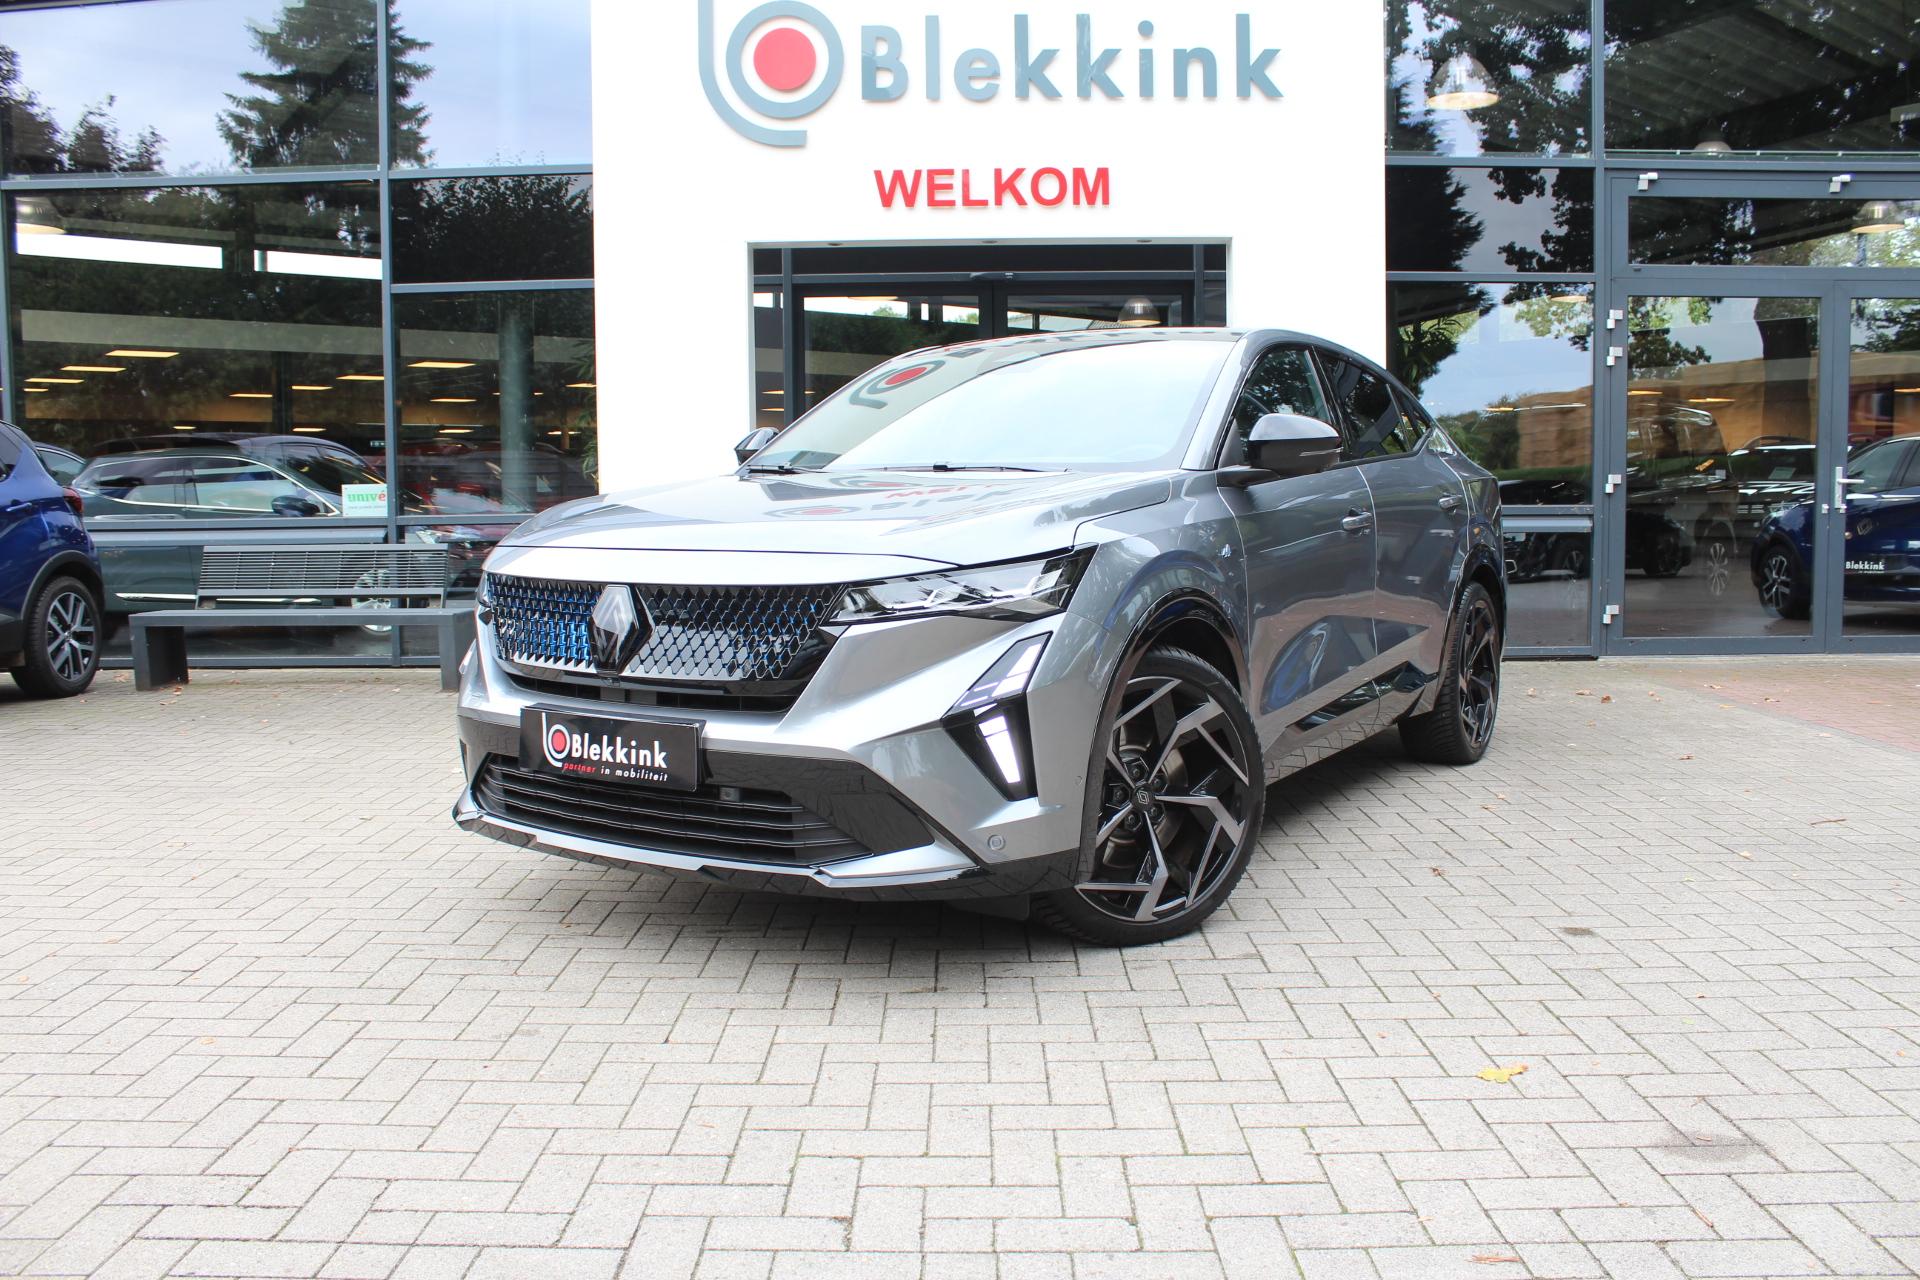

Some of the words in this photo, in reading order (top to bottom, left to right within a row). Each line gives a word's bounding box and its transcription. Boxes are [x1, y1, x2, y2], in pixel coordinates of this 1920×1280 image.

[861, 13, 1284, 100] Blekkink
[873, 167, 1110, 208] WELKOM
[347, 489, 386, 502] univé
[1845, 560, 1885, 570] Blekkink
[571, 732, 668, 769] Blekkink
[562, 762, 597, 774] partner
[600, 765, 611, 775] in
[615, 768, 668, 782] mobiliteit
